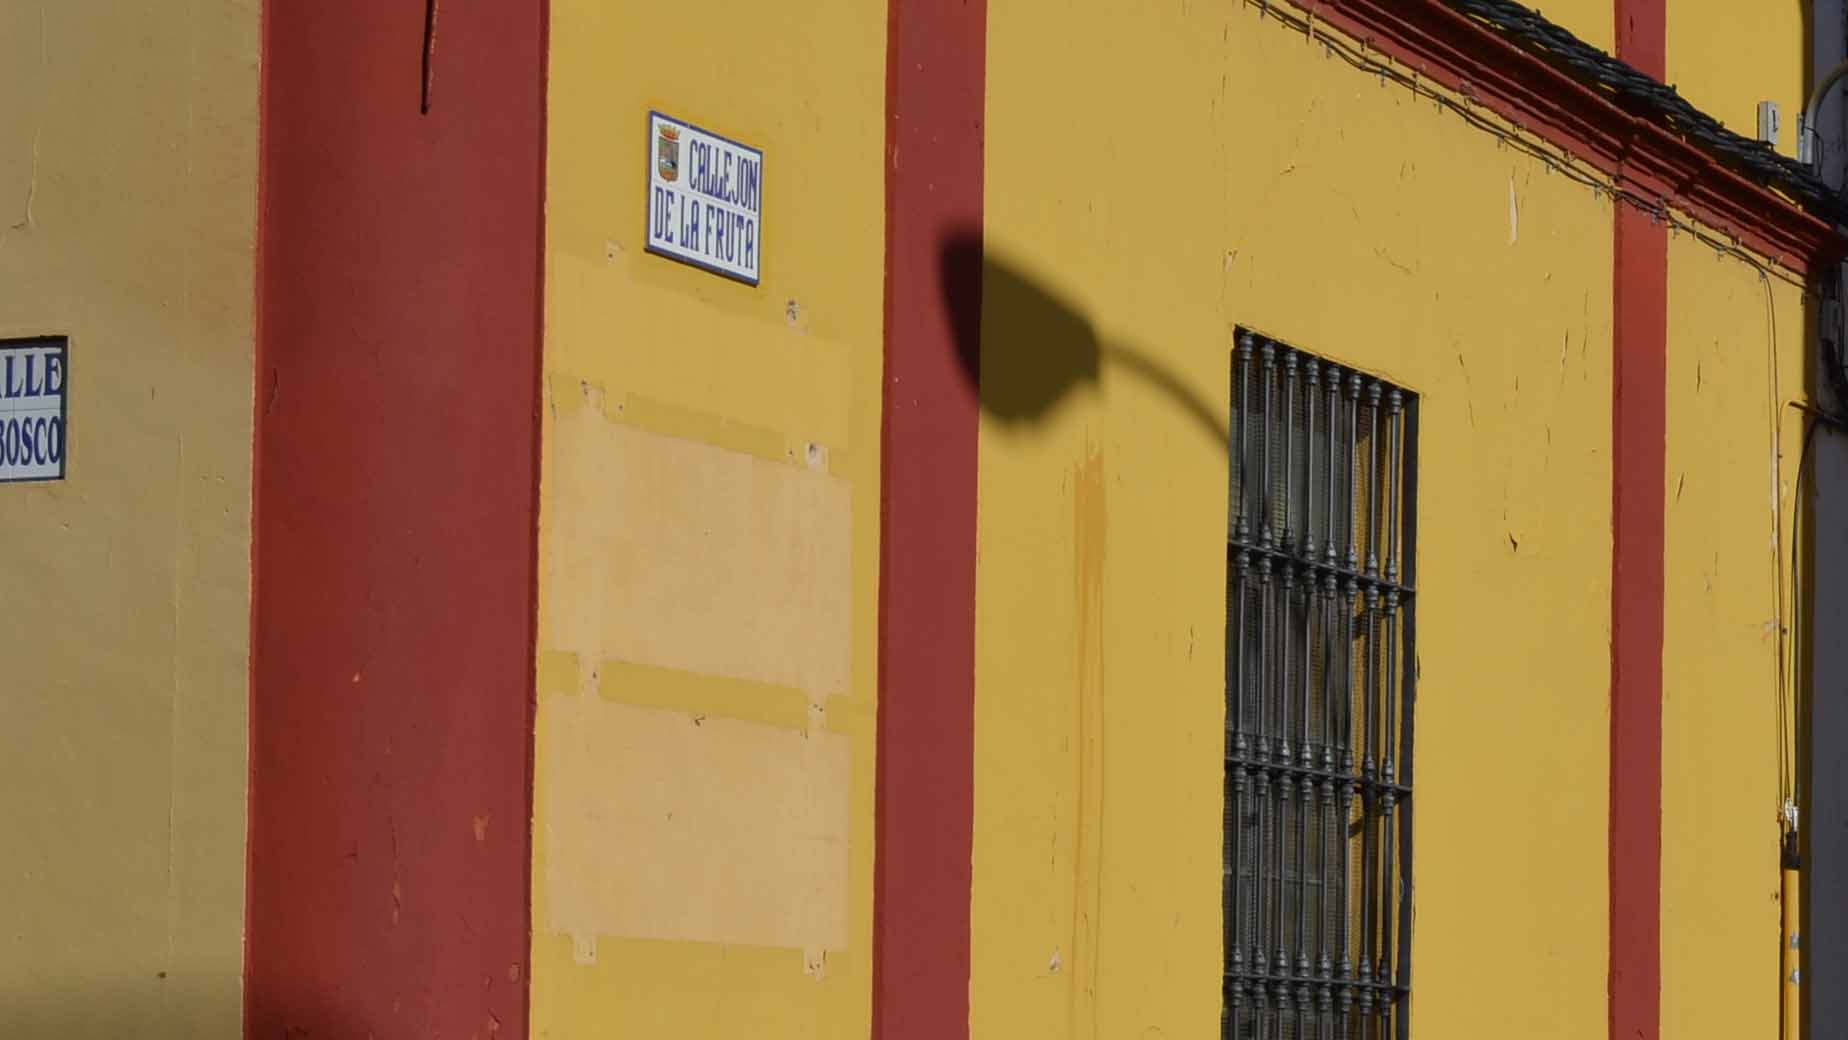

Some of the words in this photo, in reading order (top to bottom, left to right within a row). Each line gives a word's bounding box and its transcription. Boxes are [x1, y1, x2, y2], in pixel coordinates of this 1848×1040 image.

[689, 138, 758, 212] CALLEJON
[654, 186, 674, 243] DE
[680, 196, 699, 251] LA
[705, 203, 754, 269] FRUTA
[0, 353, 62, 398] LLE
